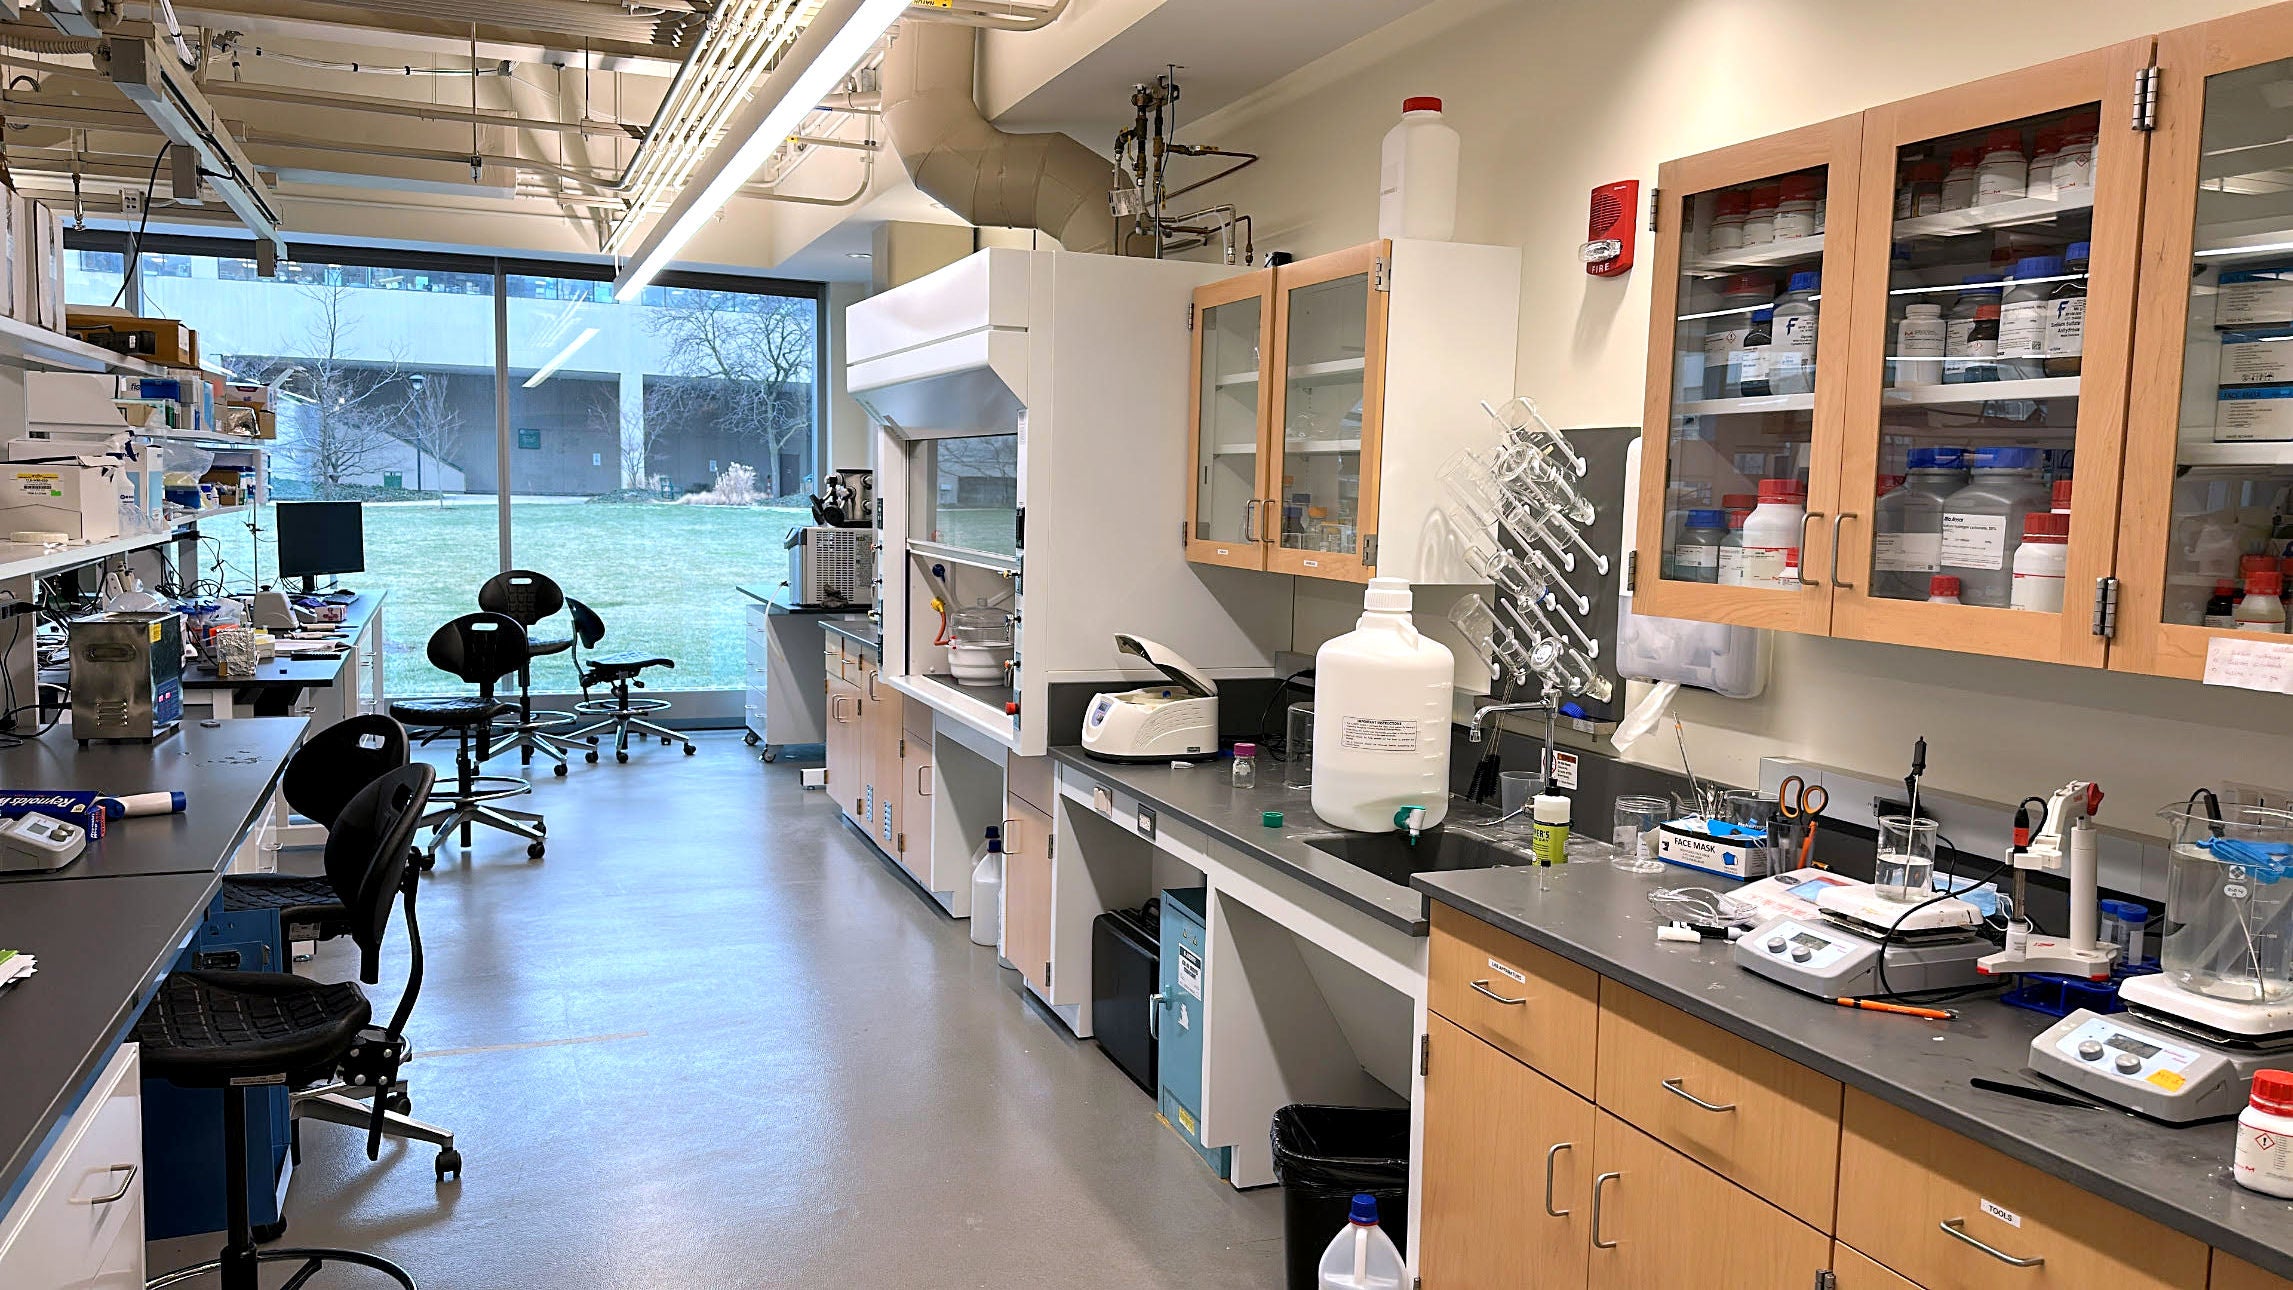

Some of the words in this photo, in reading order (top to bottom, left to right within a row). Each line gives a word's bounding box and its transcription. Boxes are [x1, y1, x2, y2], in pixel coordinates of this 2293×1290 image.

[1592, 263, 1610, 274] FIRE
[130, 383, 141, 391] fis
[9, 795, 76, 808] Reynolds
[1535, 829, 1550, 839] ER'S
[1674, 837, 1692, 849] FACE
[1693, 842, 1716, 854] MASK
[1989, 1204, 2012, 1222] TOOLS
